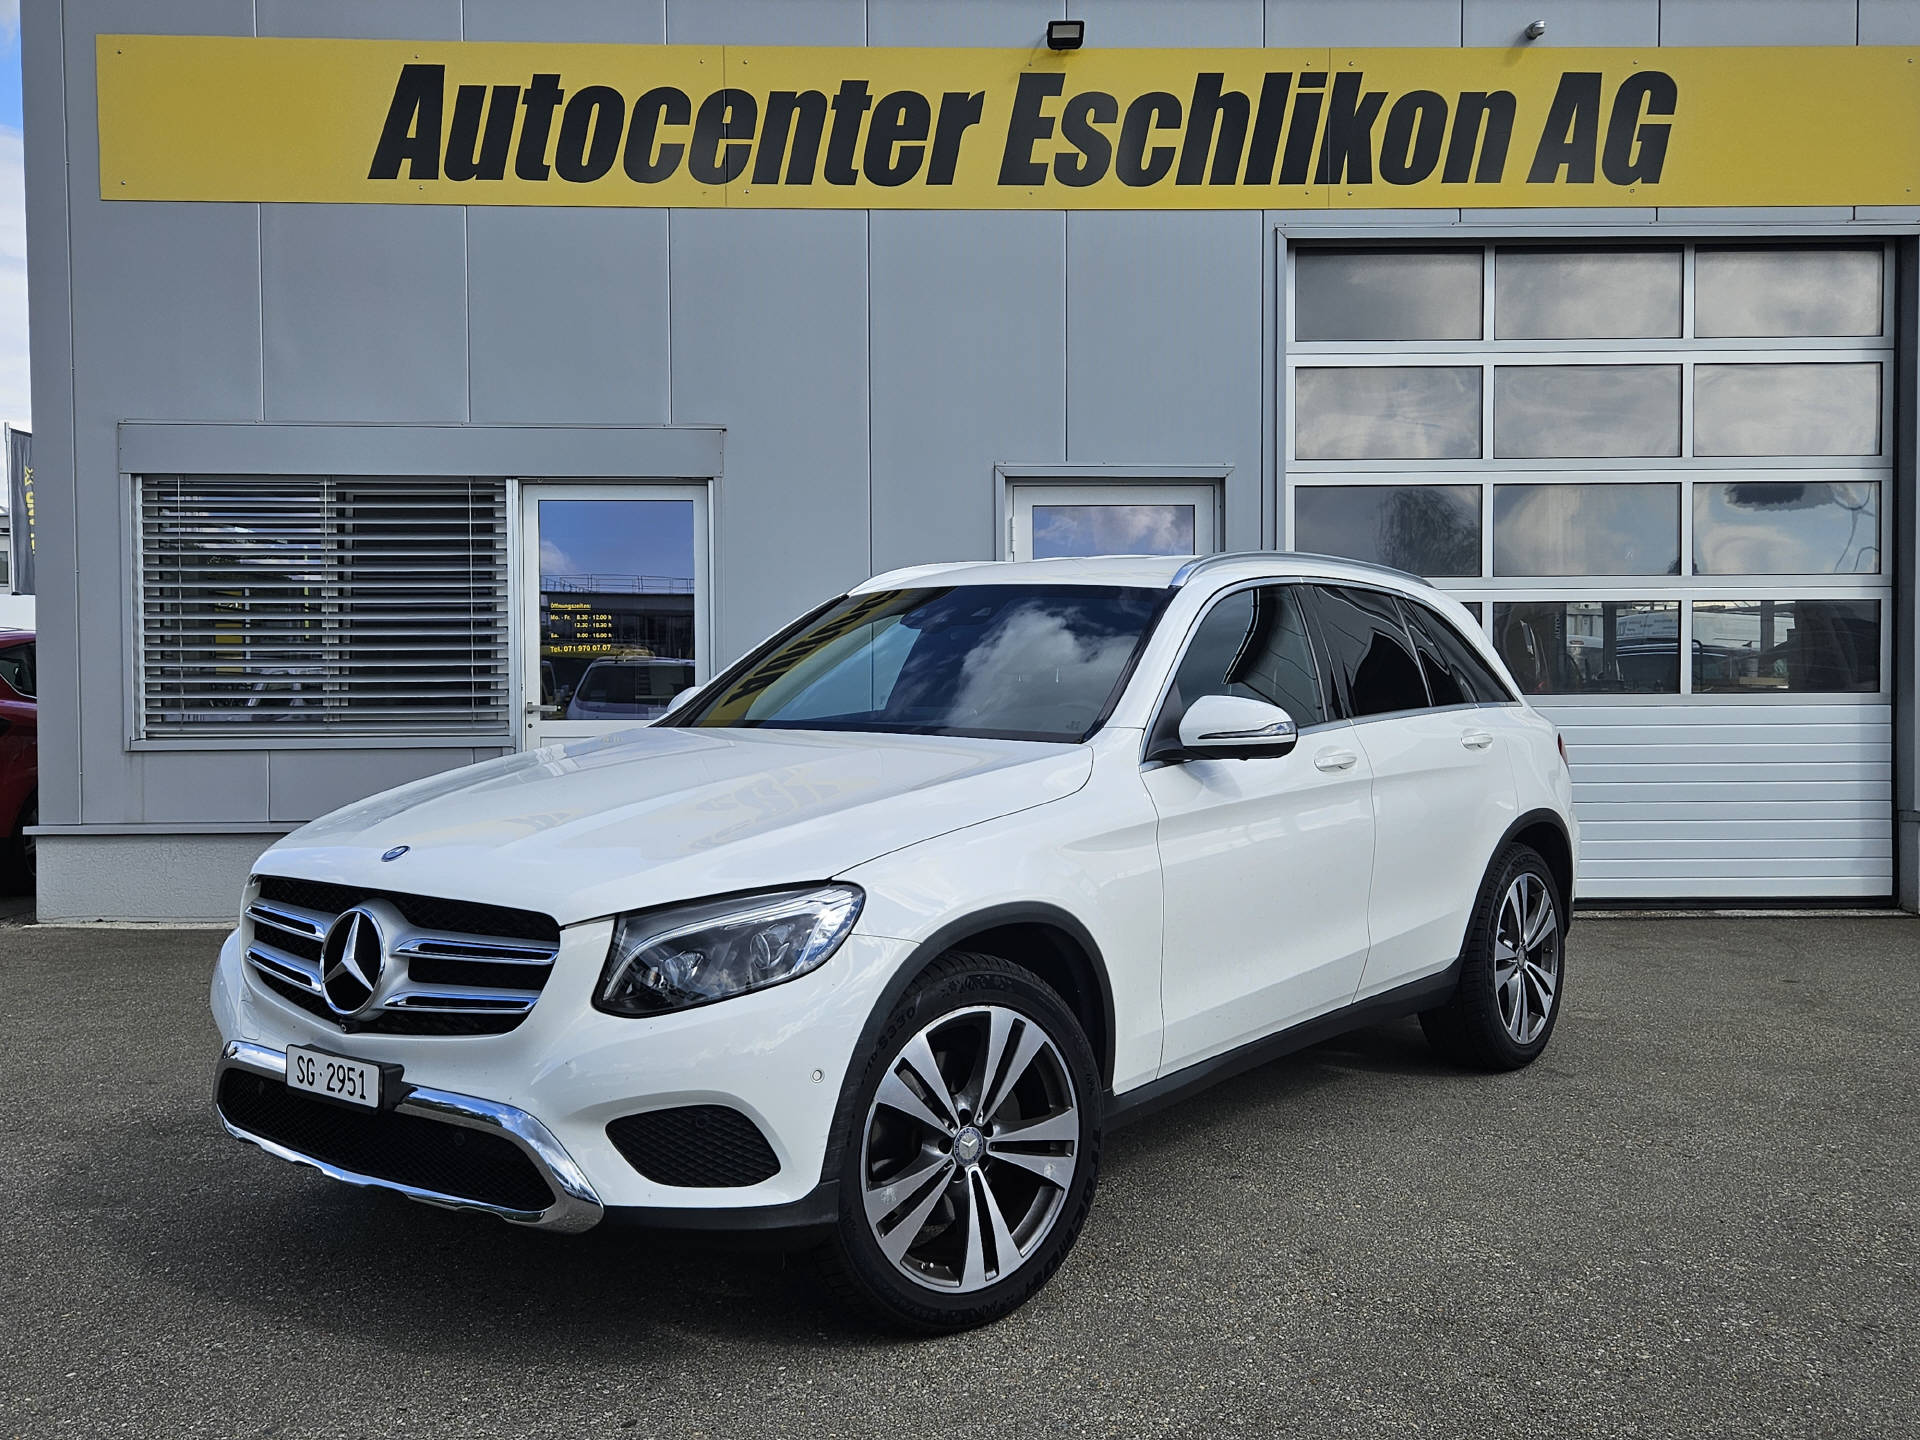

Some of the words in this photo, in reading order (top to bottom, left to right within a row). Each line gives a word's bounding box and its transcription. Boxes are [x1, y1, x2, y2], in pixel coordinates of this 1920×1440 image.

[367, 64, 985, 187] Autocenter
[997, 71, 1516, 187] Eschlikon
[1526, 70, 1678, 186] AG
[297, 1055, 315, 1086] SG
[326, 1063, 366, 1100] 2951
